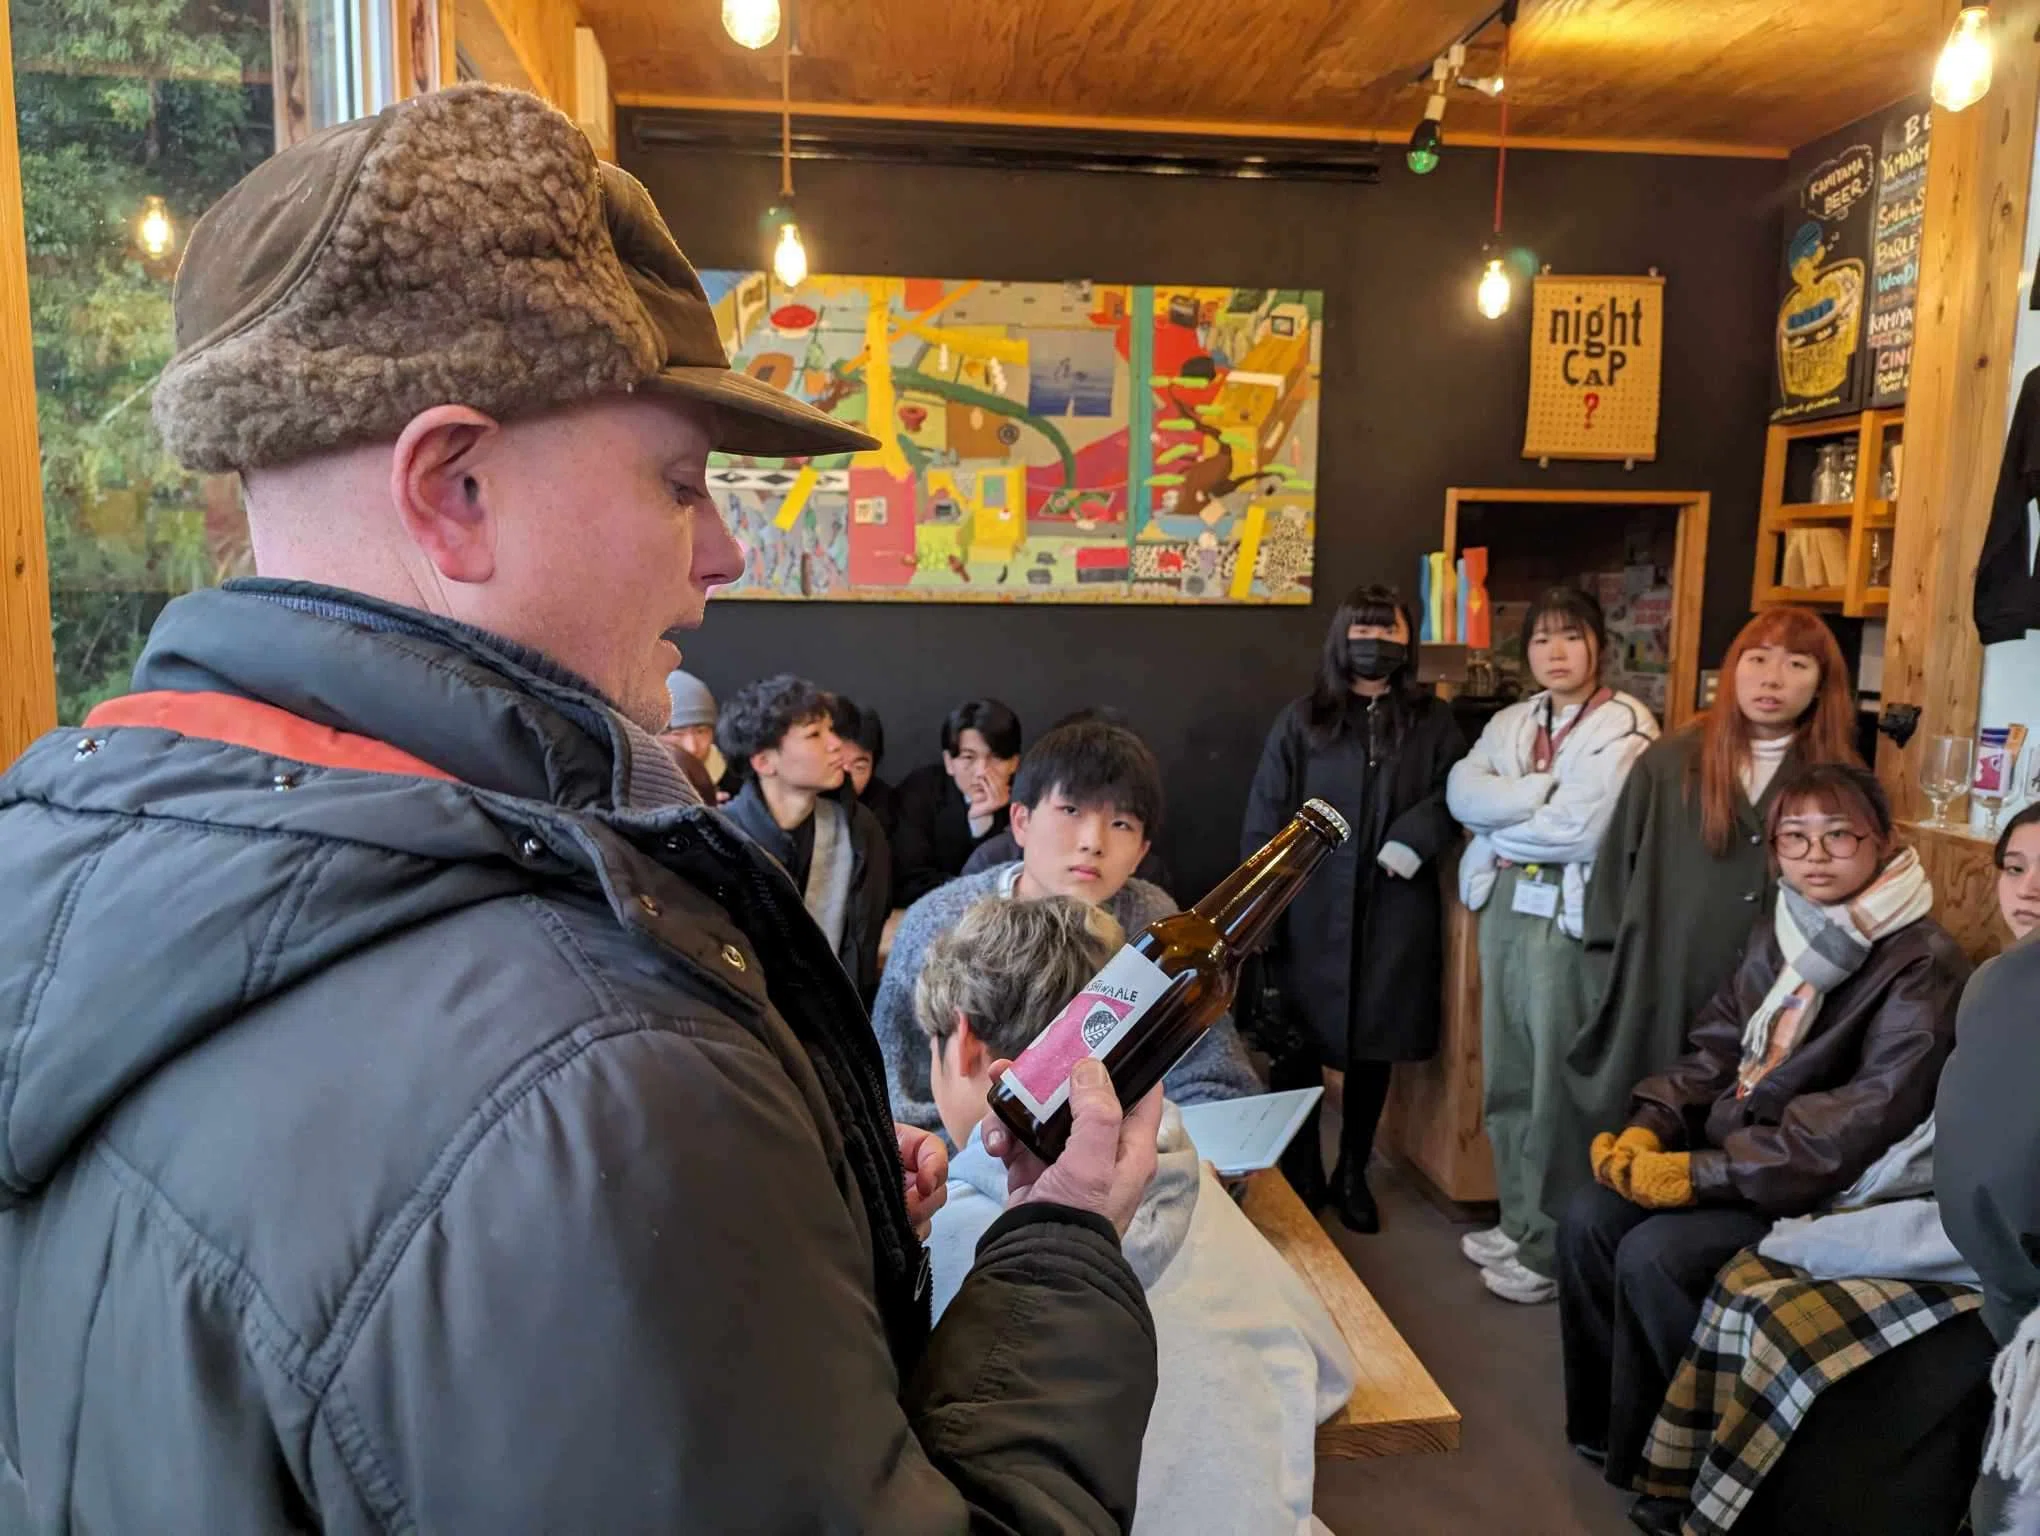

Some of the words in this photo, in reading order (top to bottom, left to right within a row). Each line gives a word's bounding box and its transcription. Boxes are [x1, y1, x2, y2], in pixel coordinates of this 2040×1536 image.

[1811, 157, 1864, 200] KAMIYAMA
[1824, 178, 1864, 214] BEER
[1550, 295, 1643, 359] night
[1563, 349, 1627, 387] CAP
